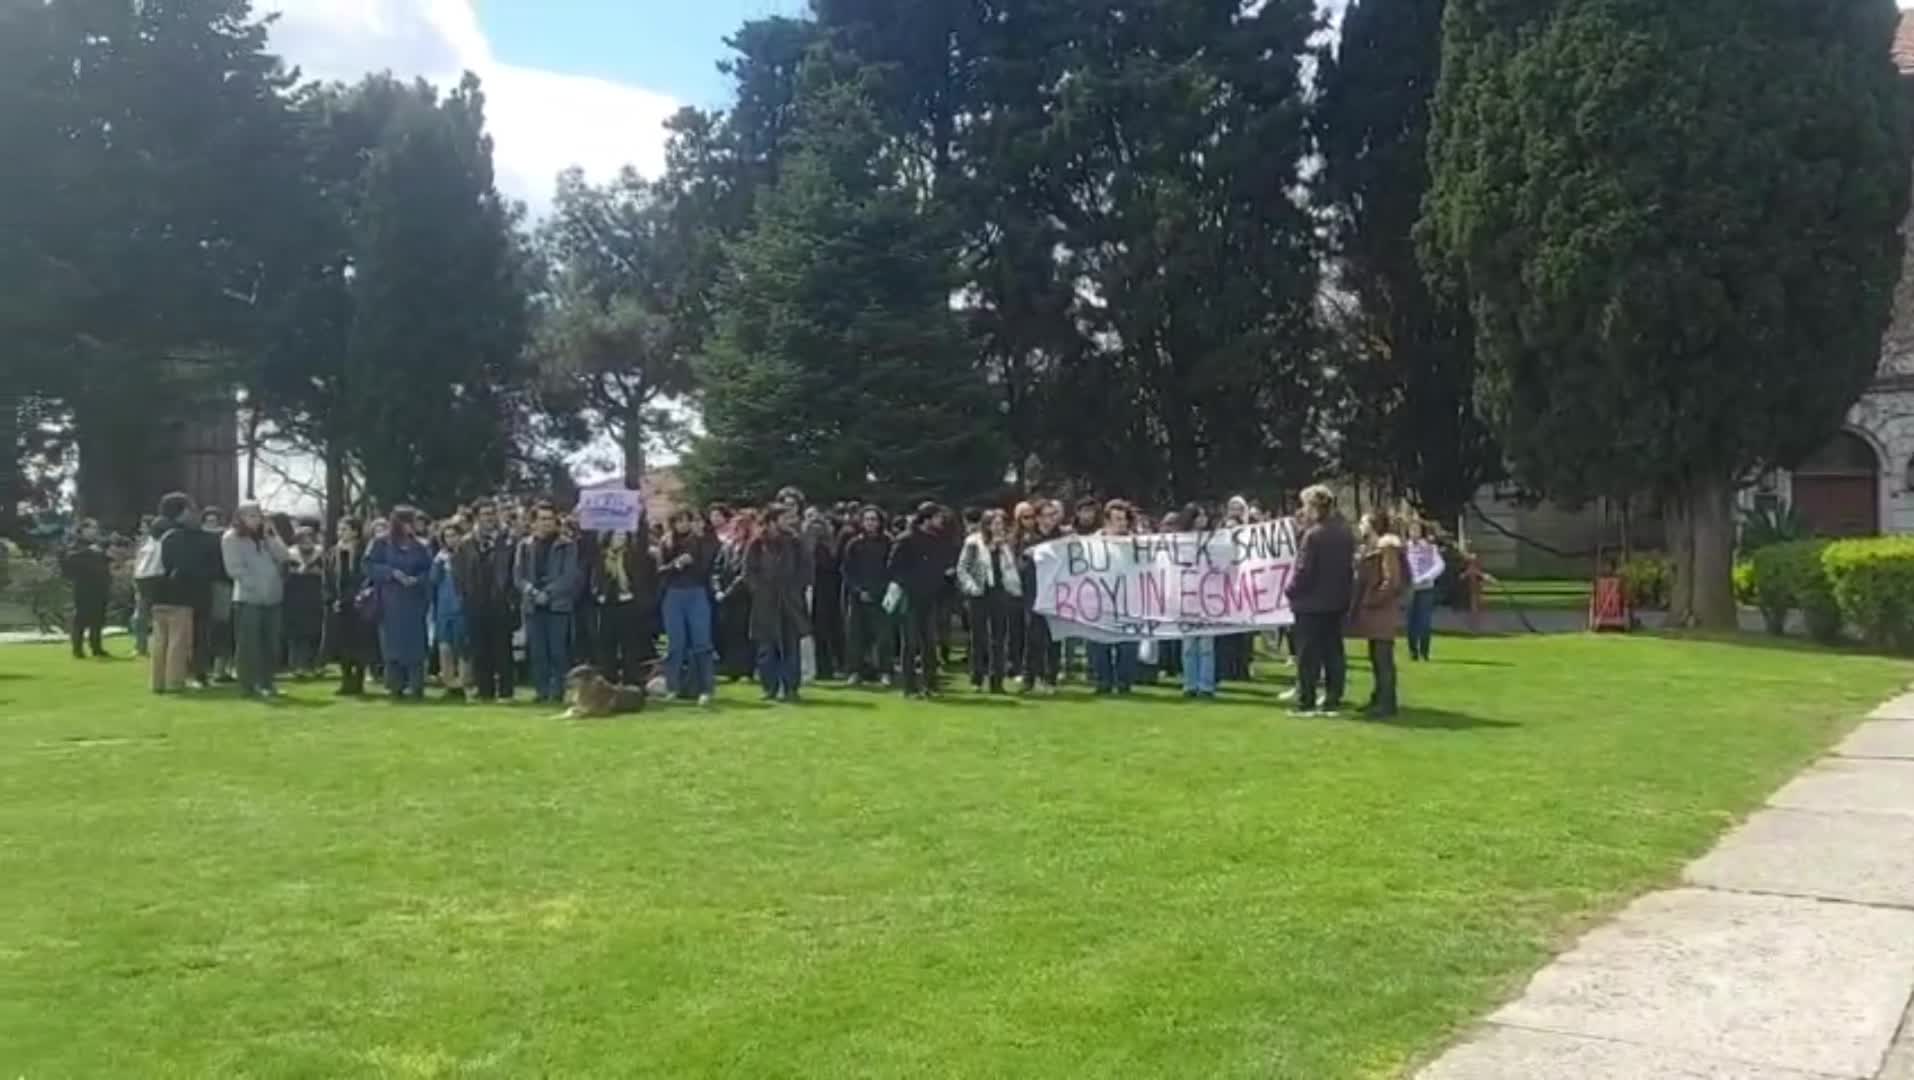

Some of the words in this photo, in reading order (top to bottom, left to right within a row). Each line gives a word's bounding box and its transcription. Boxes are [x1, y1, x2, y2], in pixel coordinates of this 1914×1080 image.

[1067, 541, 1111, 575] BU
[1132, 535, 1212, 568] HALK
[1229, 519, 1295, 565] SANA
[1055, 570, 1166, 623] BOYUN
